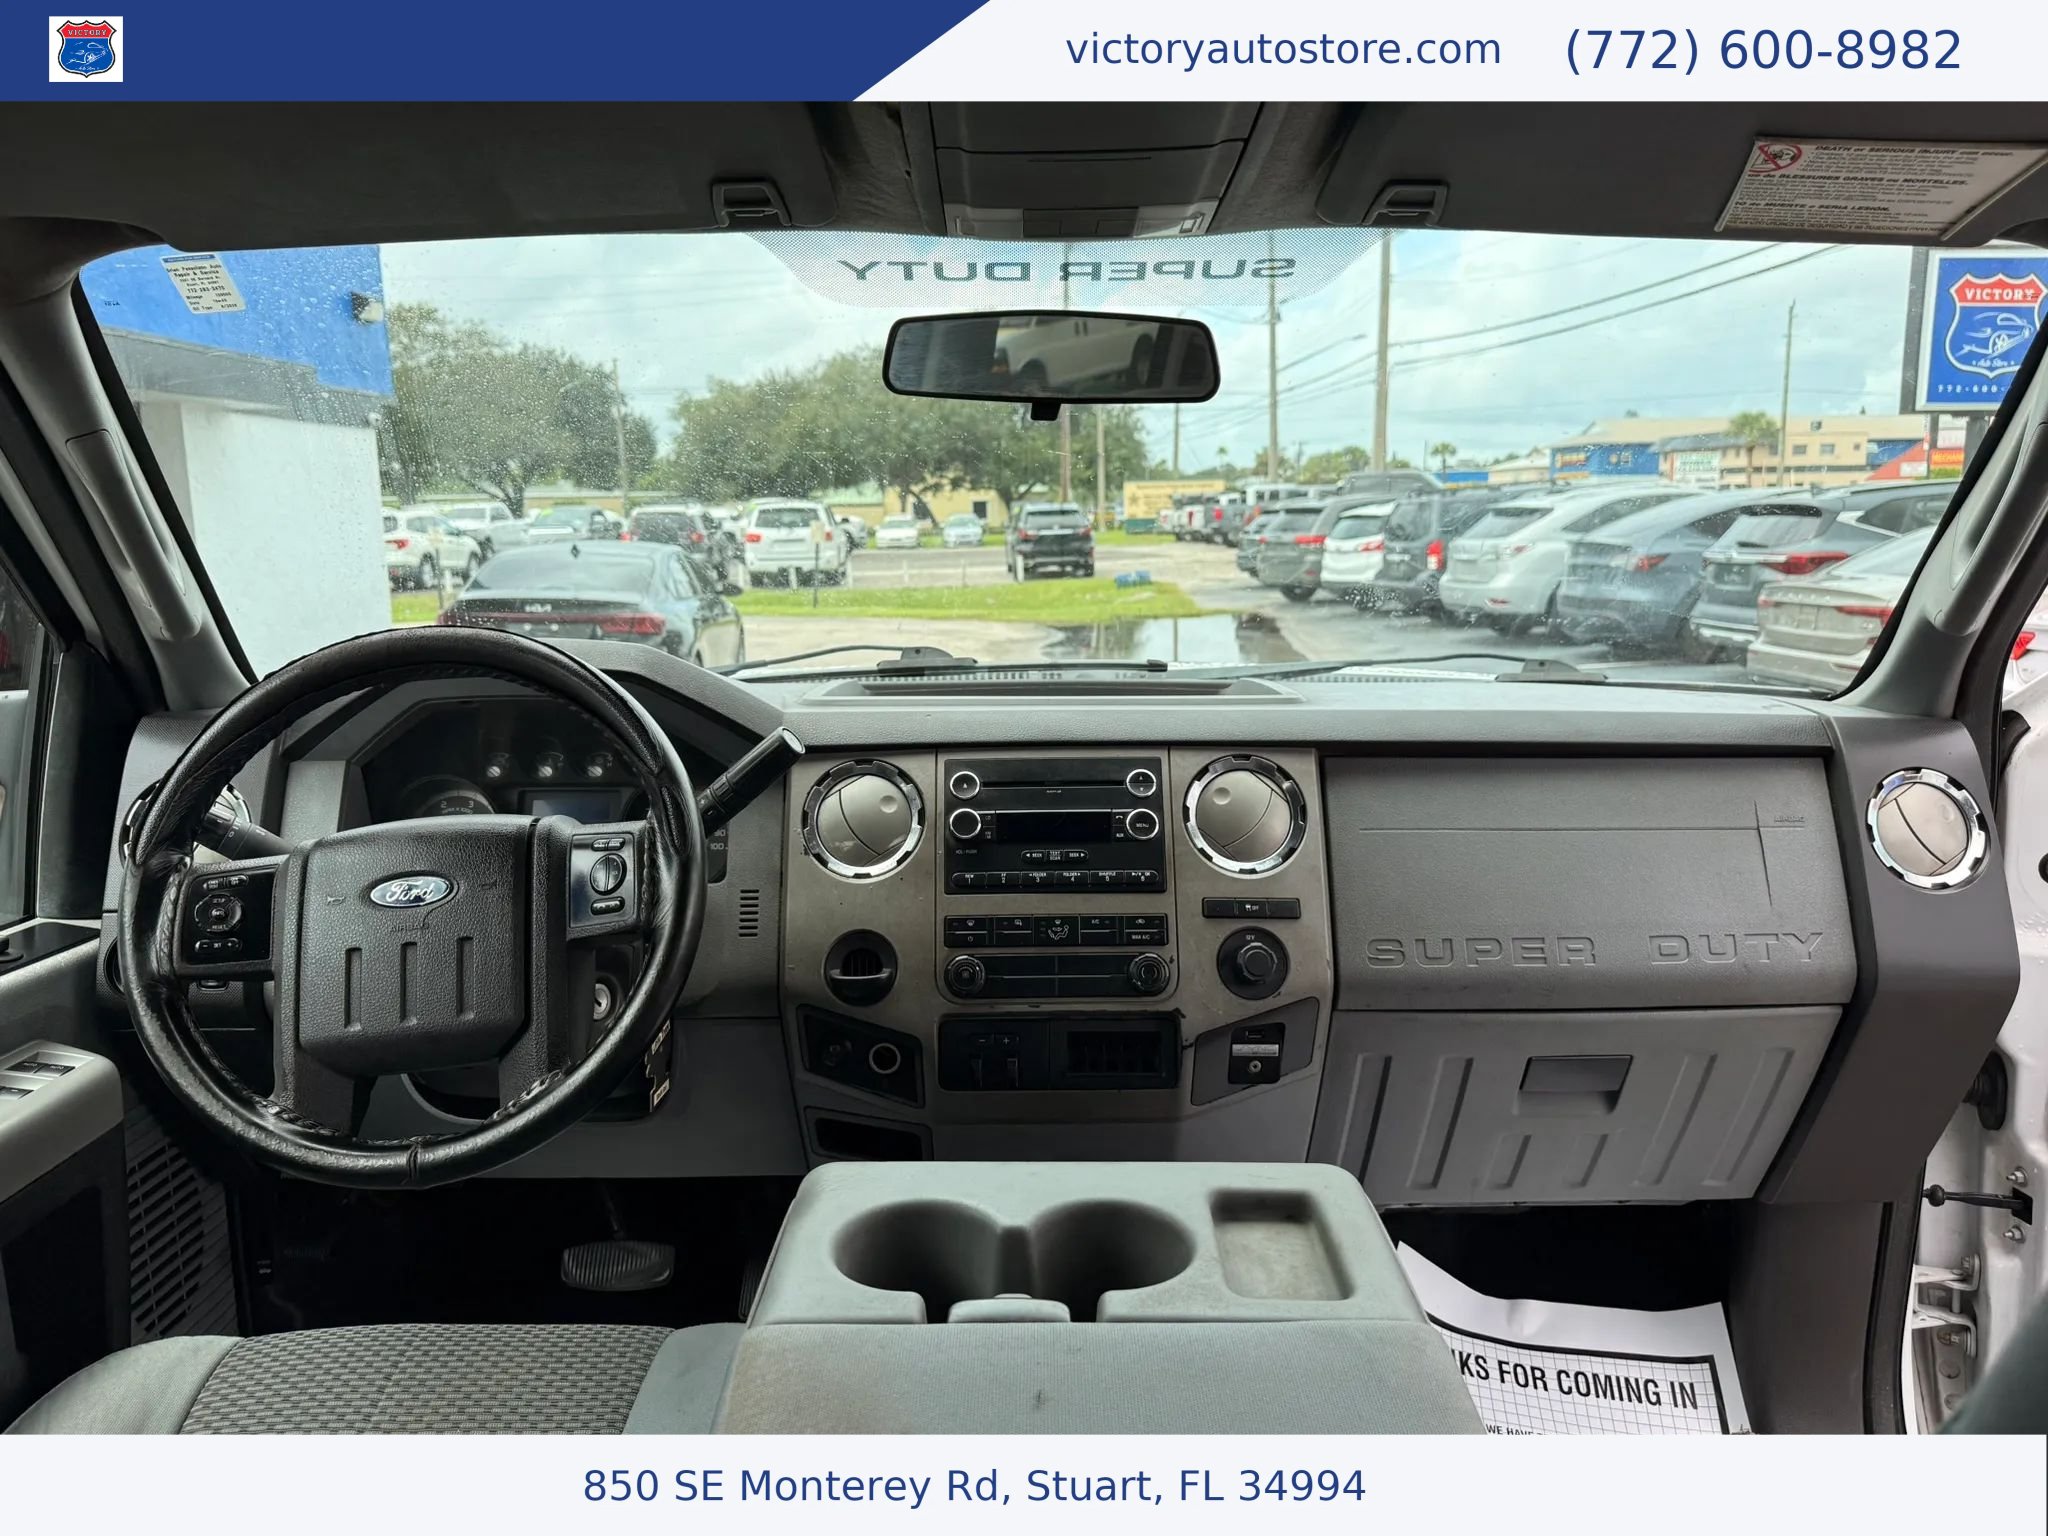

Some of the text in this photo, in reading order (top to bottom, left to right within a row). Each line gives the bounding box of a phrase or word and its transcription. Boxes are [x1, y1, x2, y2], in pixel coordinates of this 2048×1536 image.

[1778, 173, 1841, 181] BLESSURES
[1902, 177, 1969, 185] MORTELLES.
[1964, 287, 2035, 300] VICTORY
[385, 880, 435, 901] Ford
[1365, 932, 1824, 968] SUPER DUTY
[1451, 1349, 1699, 1411] KS FOR COMING IN
